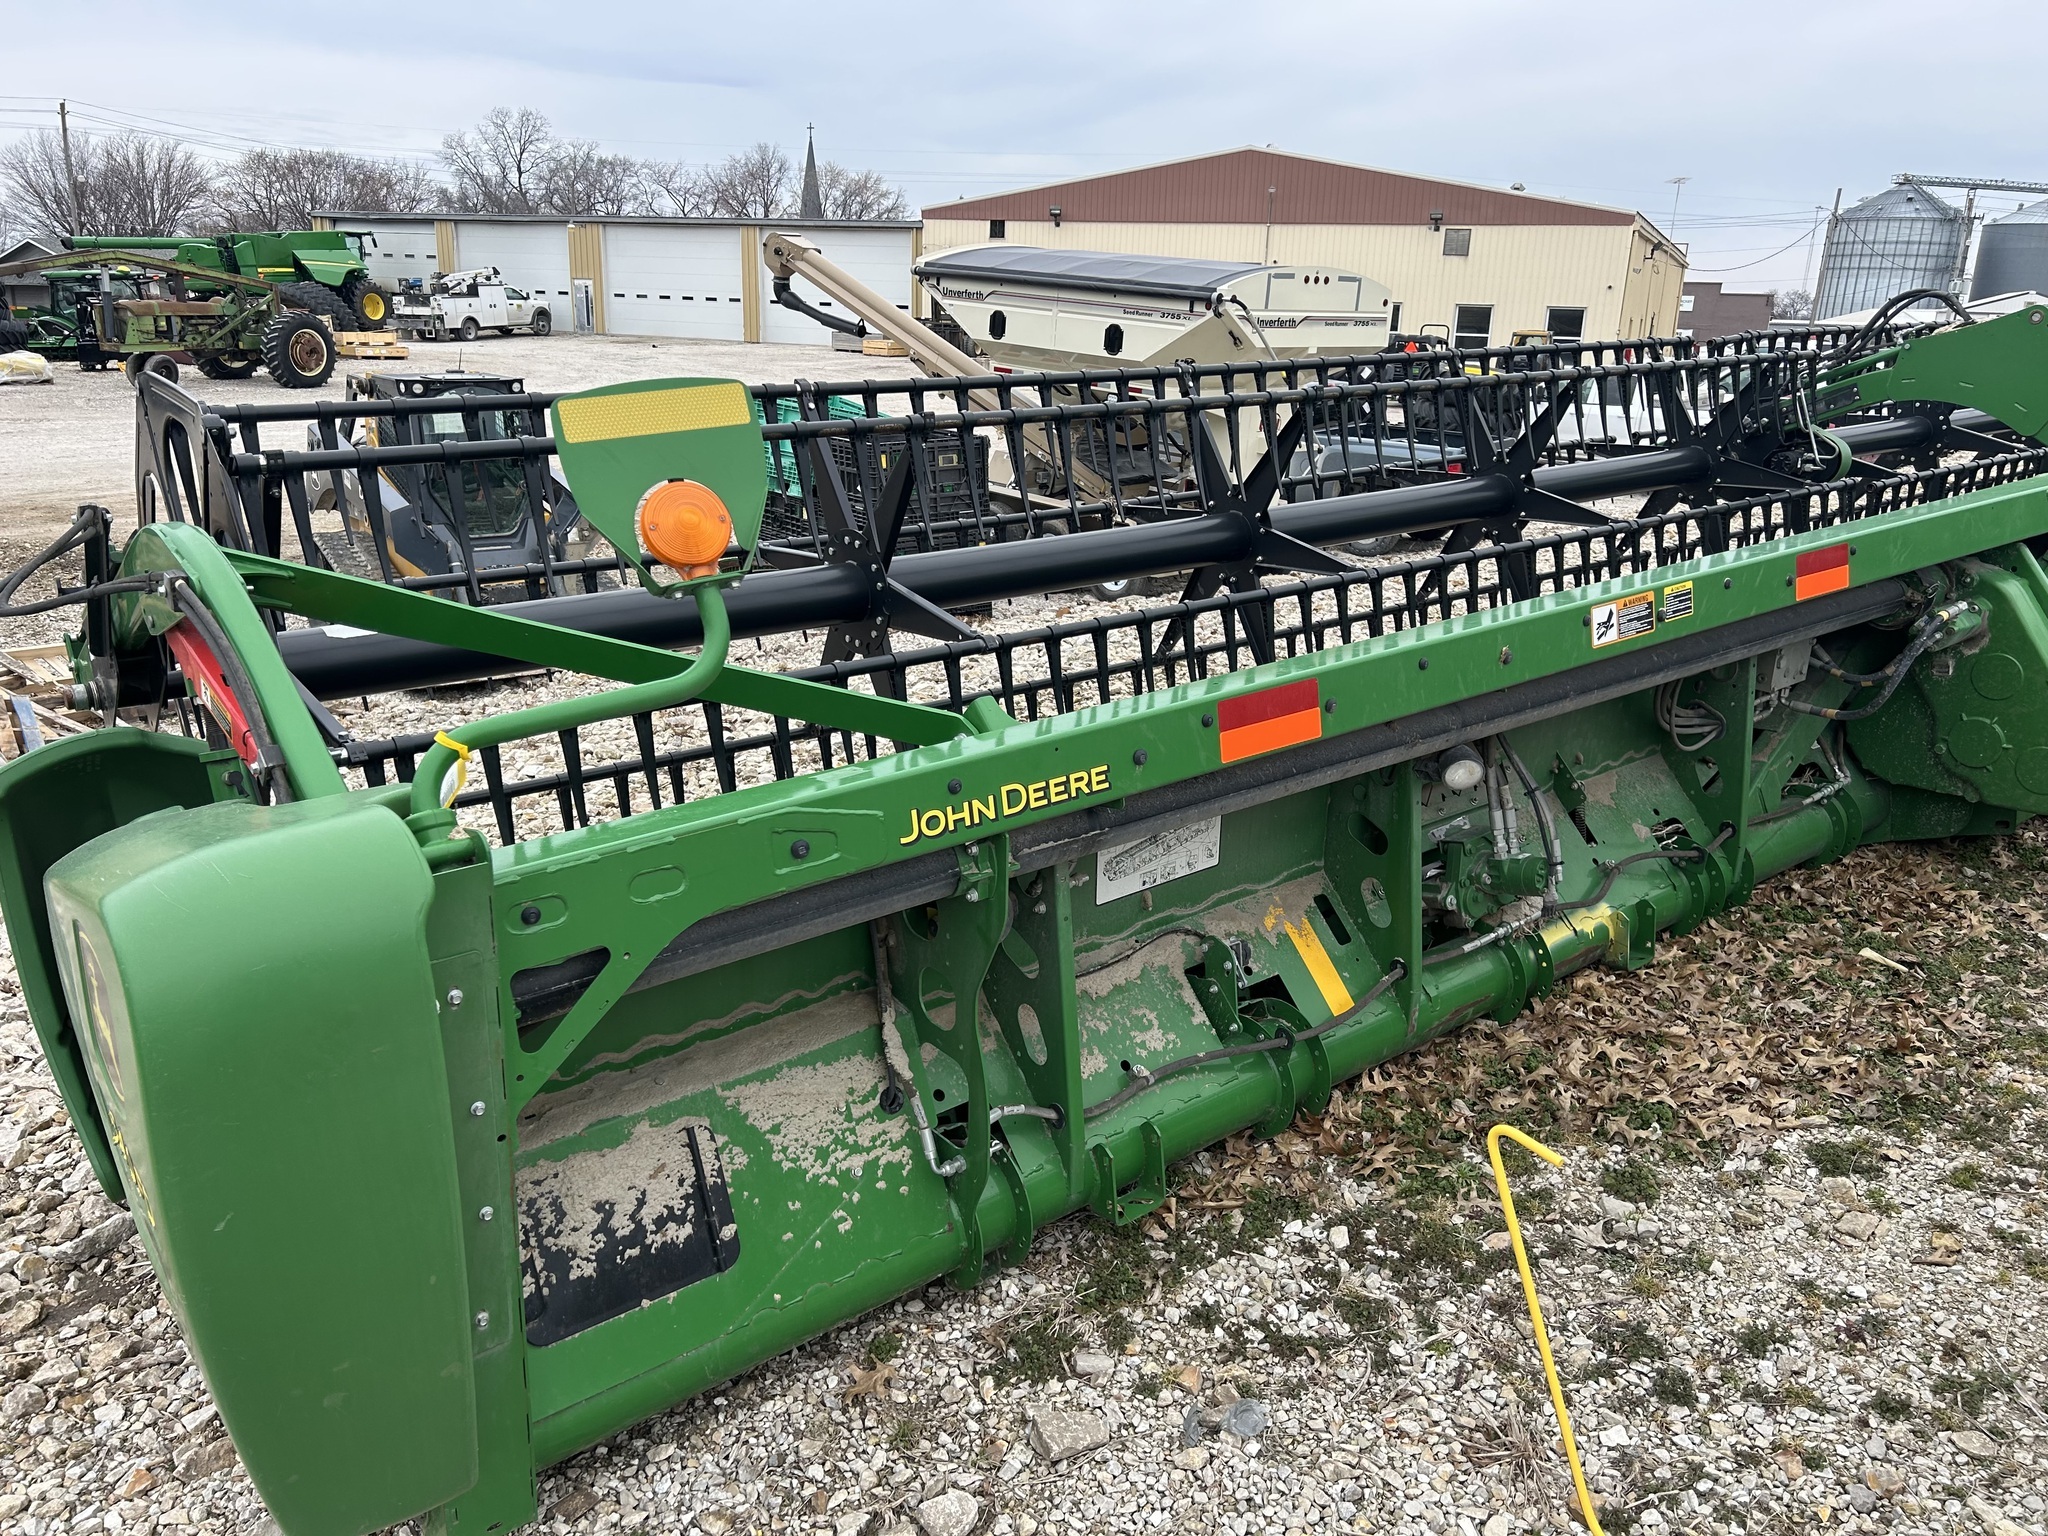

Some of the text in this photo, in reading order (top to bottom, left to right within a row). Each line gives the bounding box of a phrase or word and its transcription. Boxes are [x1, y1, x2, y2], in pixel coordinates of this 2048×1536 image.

[942, 286, 984, 300] Unverferth
[1135, 310, 1153, 318] Runner
[1160, 311, 1182, 320] 3755
[1627, 595, 1649, 606] WARNING
[900, 764, 1112, 847] JOHN DEERE
